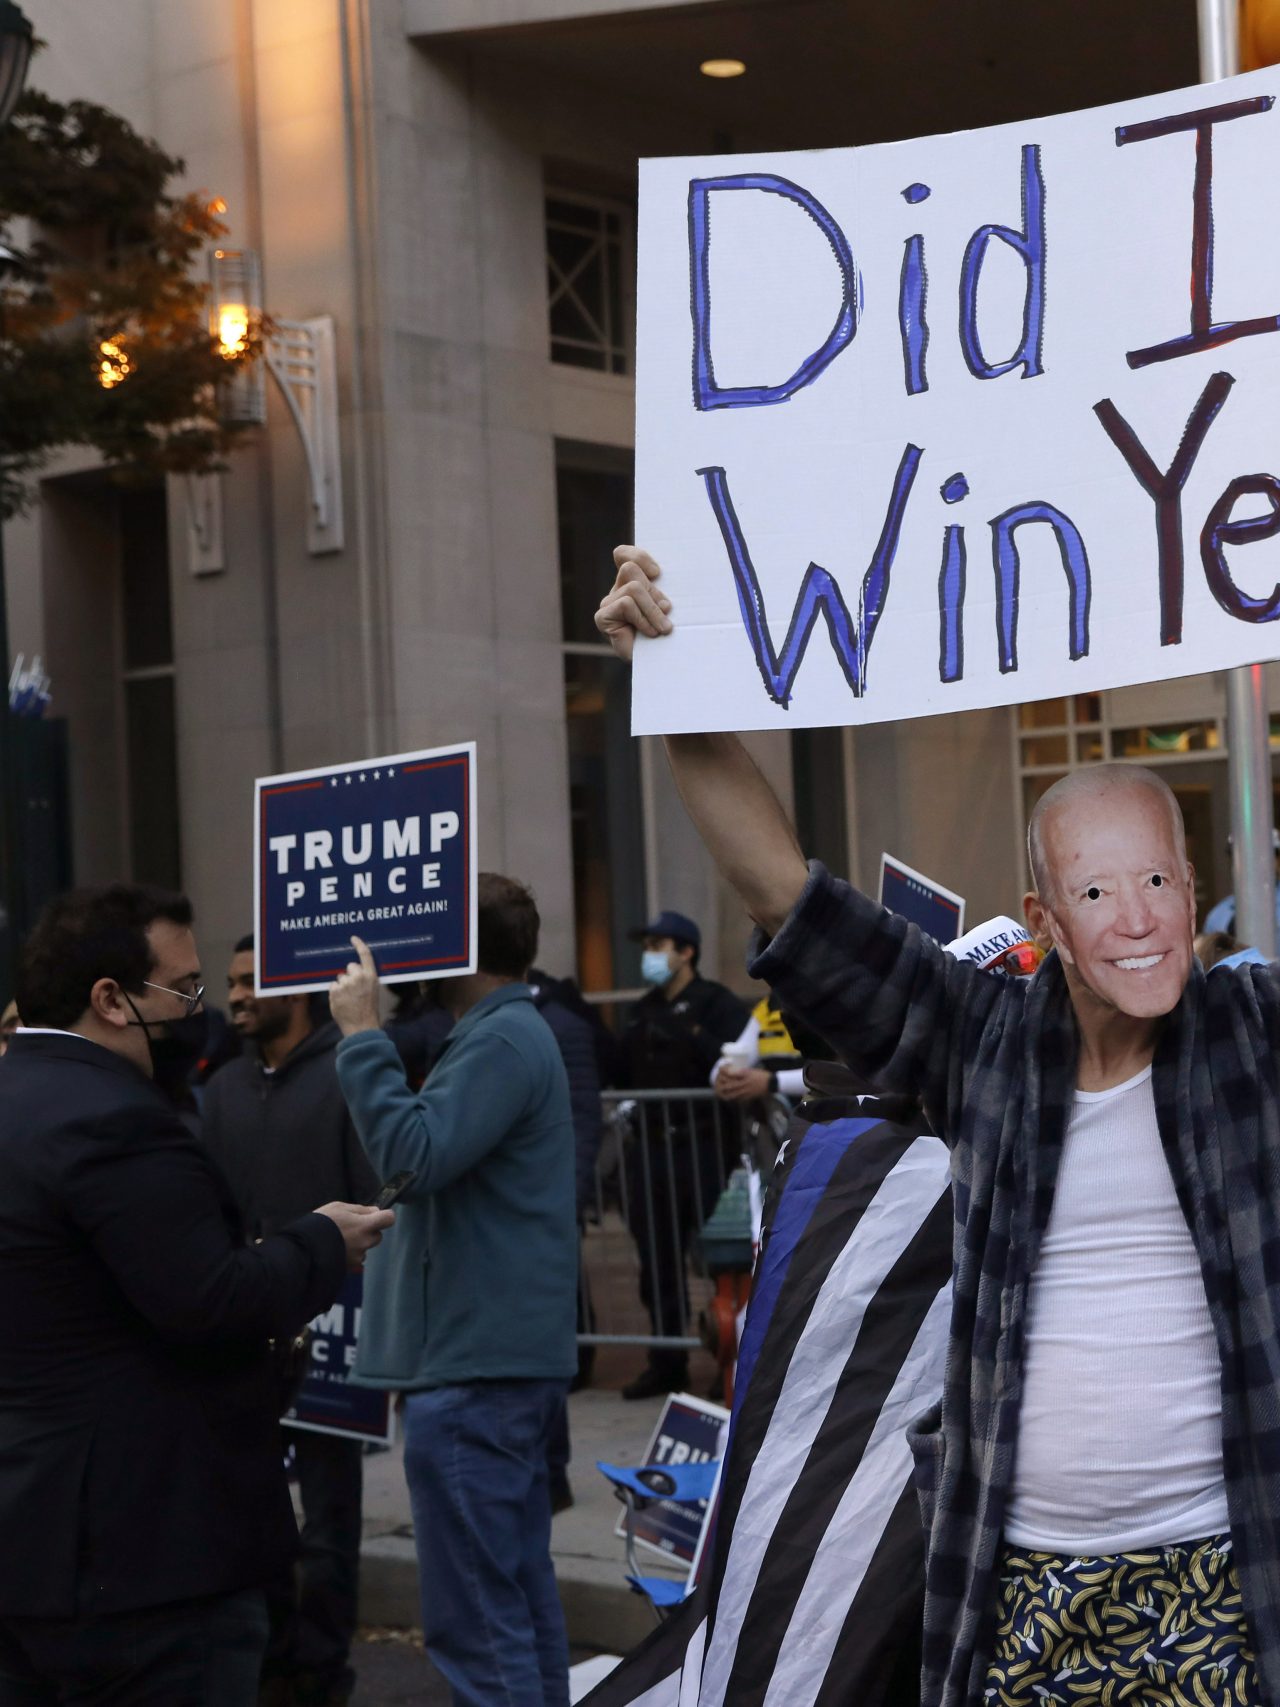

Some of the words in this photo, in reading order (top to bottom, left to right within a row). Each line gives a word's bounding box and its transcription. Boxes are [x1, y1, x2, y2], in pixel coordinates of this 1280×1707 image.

[688, 144, 1046, 411] Did
[694, 444, 1091, 710] Win
[269, 810, 460, 875] TRUMP
[286, 862, 441, 907] PENCE
[280, 916, 311, 931] MAKE
[313, 910, 364, 927] AMERICA
[367, 905, 404, 922] GREAT
[407, 899, 449, 916] AGAIN!
[966, 932, 1014, 963] MAKE
